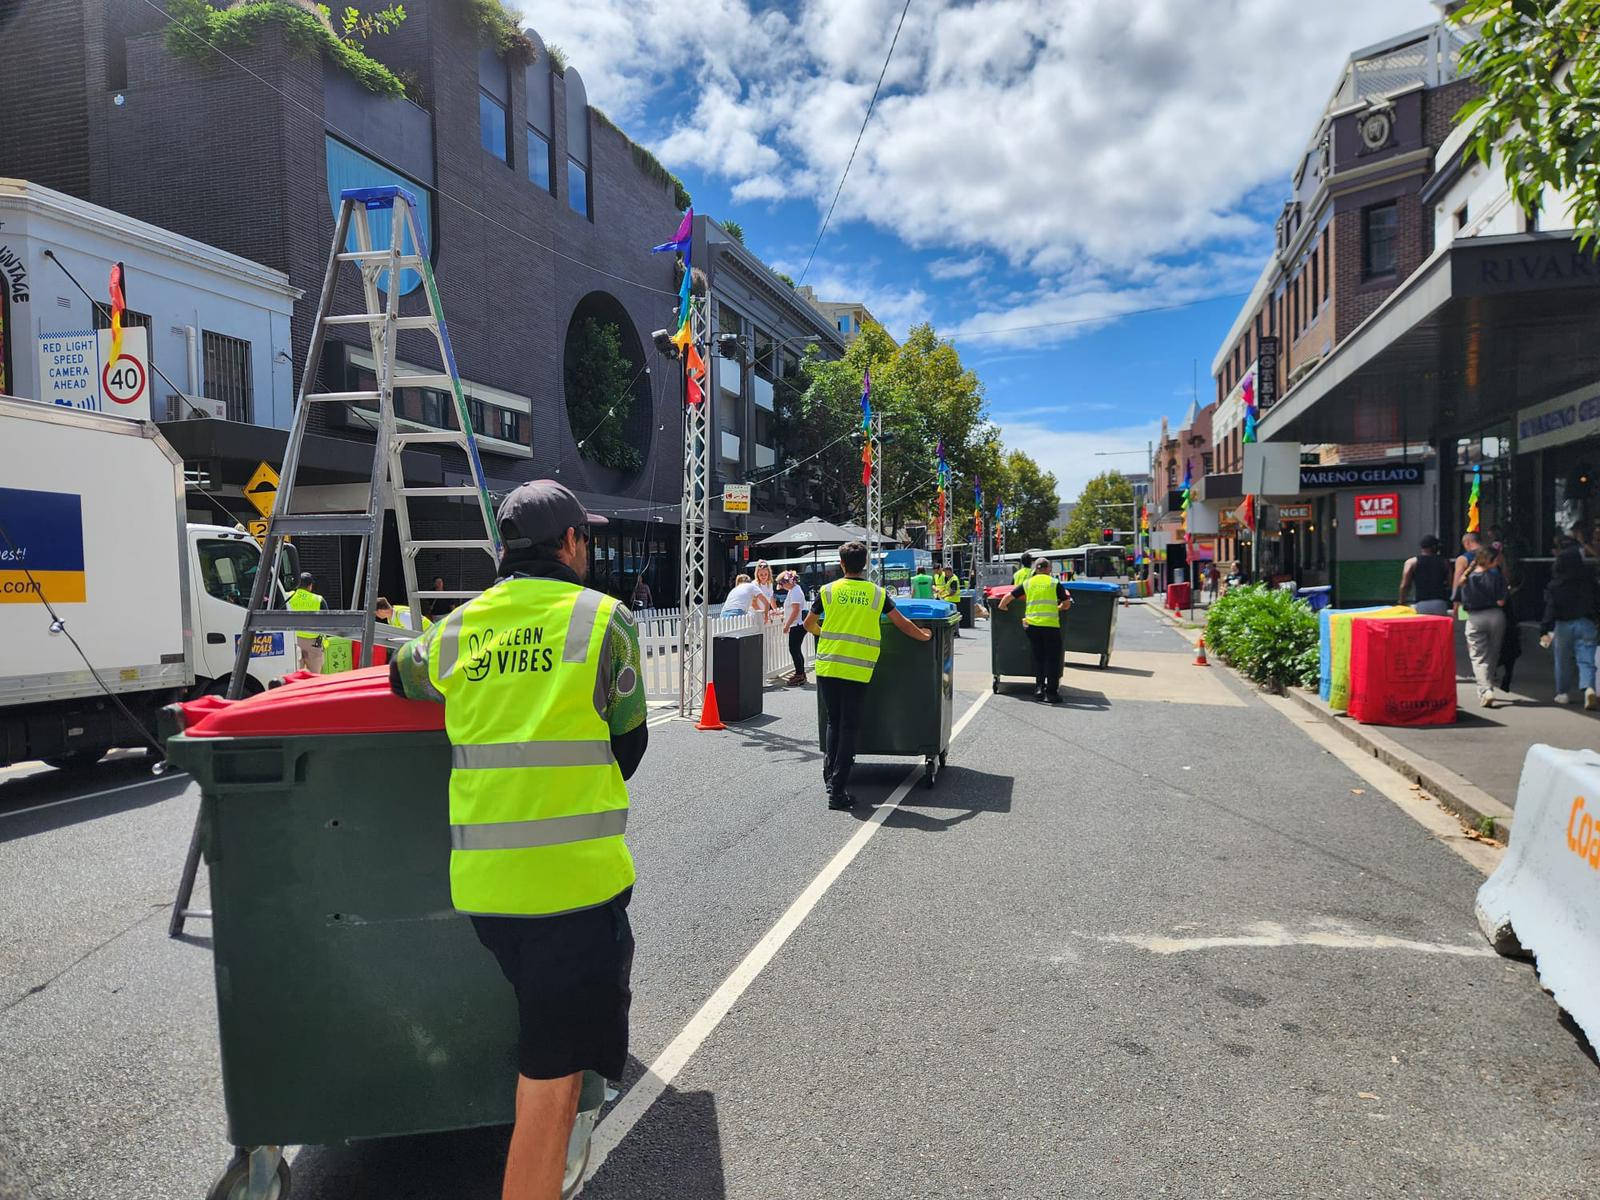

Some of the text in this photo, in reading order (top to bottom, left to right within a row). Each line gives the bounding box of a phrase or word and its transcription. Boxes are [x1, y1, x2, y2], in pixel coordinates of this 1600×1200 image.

[43, 340, 93, 353] RED LIGHT
[54, 354, 84, 365] SPEED
[49, 367, 90, 378] CAMERA
[53, 379, 87, 390] AHEAD
[110, 368, 137, 390] 40
[1301, 468, 1418, 483] VARENO GELATO
[1360, 498, 1393, 510] VIP
[850, 596, 869, 606] VIBES
[500, 627, 543, 646] CLEAN
[497, 648, 553, 674] VIBES
